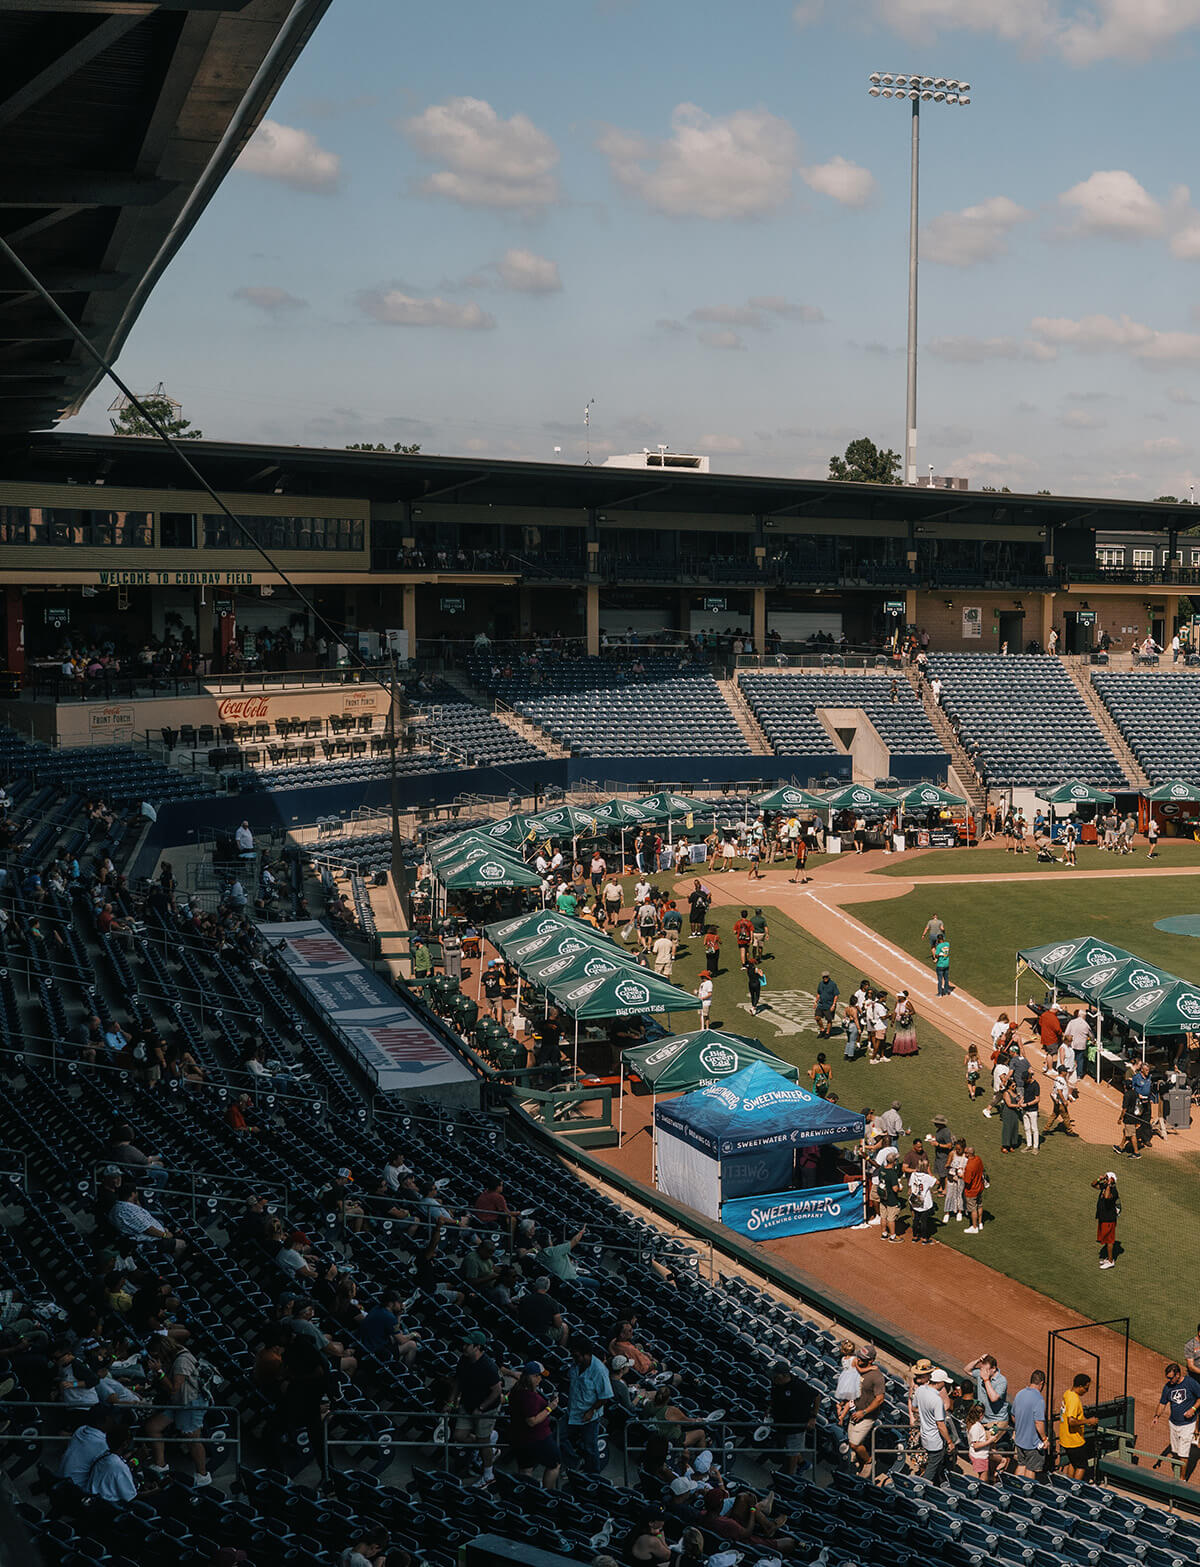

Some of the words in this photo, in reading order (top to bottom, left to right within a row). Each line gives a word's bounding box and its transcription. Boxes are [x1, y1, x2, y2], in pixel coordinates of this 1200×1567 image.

[99, 572, 150, 584] WELCOME
[158, 573, 169, 584] TO
[175, 573, 220, 584] COOLRAY
[226, 573, 253, 584] FIELD
[218, 697, 270, 720] Coca-Cola
[93, 715, 110, 724] FRONT
[616, 1007, 628, 1015] Big
[651, 1005, 665, 1013] Egg
[367, 1028, 453, 1061] ARROW
[704, 1054, 734, 1063] Green
[709, 1049, 727, 1058] Big
[712, 1058, 731, 1067] Egg
[699, 1079, 712, 1088] Big
[702, 1084, 741, 1110] SWEETWATER
[743, 1089, 812, 1112] SWEETWATER
[736, 1134, 787, 1149] SWEETWATER
[800, 1127, 833, 1138] BREWING
[834, 1126, 849, 1134] CO.
[747, 1197, 841, 1231] SWEETWATER
[764, 1217, 792, 1228] BREWING
[793, 1212, 824, 1221] COMPANY
